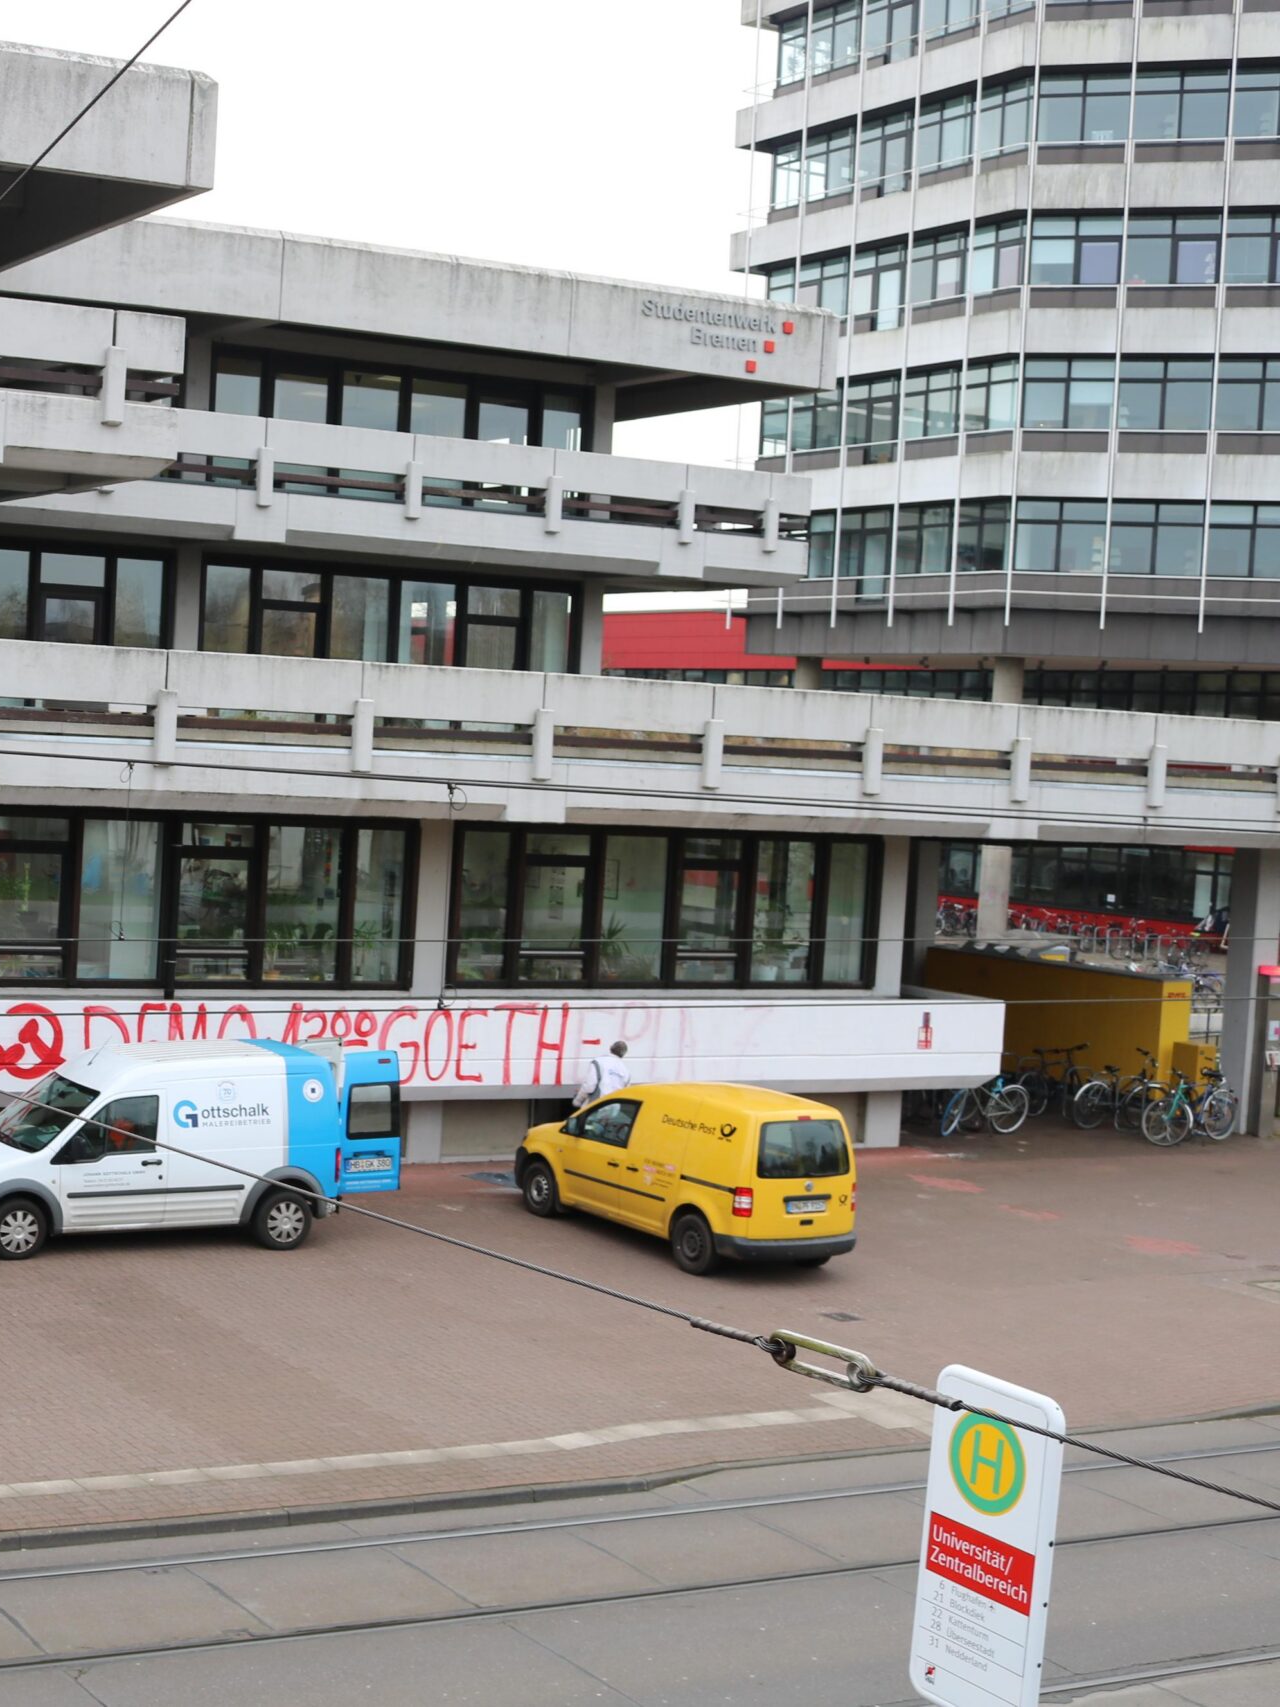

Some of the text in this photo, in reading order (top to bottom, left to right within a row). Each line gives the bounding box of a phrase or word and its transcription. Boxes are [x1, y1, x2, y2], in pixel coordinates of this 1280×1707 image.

[641, 299, 776, 334] Studentenwerk
[690, 326, 757, 353] Bremen
[173, 1100, 270, 1128] Gottschalk
[202, 1118, 272, 1128] MALEREIBETRIEB
[662, 1114, 716, 1136] Deutsche Post
[933, 1524, 1014, 1576] Universität/
[930, 1545, 1028, 1604] Zentralbereich
[933, 1590, 986, 1622] 21 Blockdiek
[939, 1580, 987, 1609] 6 Flughafen
[930, 1618, 995, 1658] 28 Überseestadt
[931, 1606, 990, 1641] 22 Kattenturm
[928, 1635, 988, 1672] 31 Nedderland
